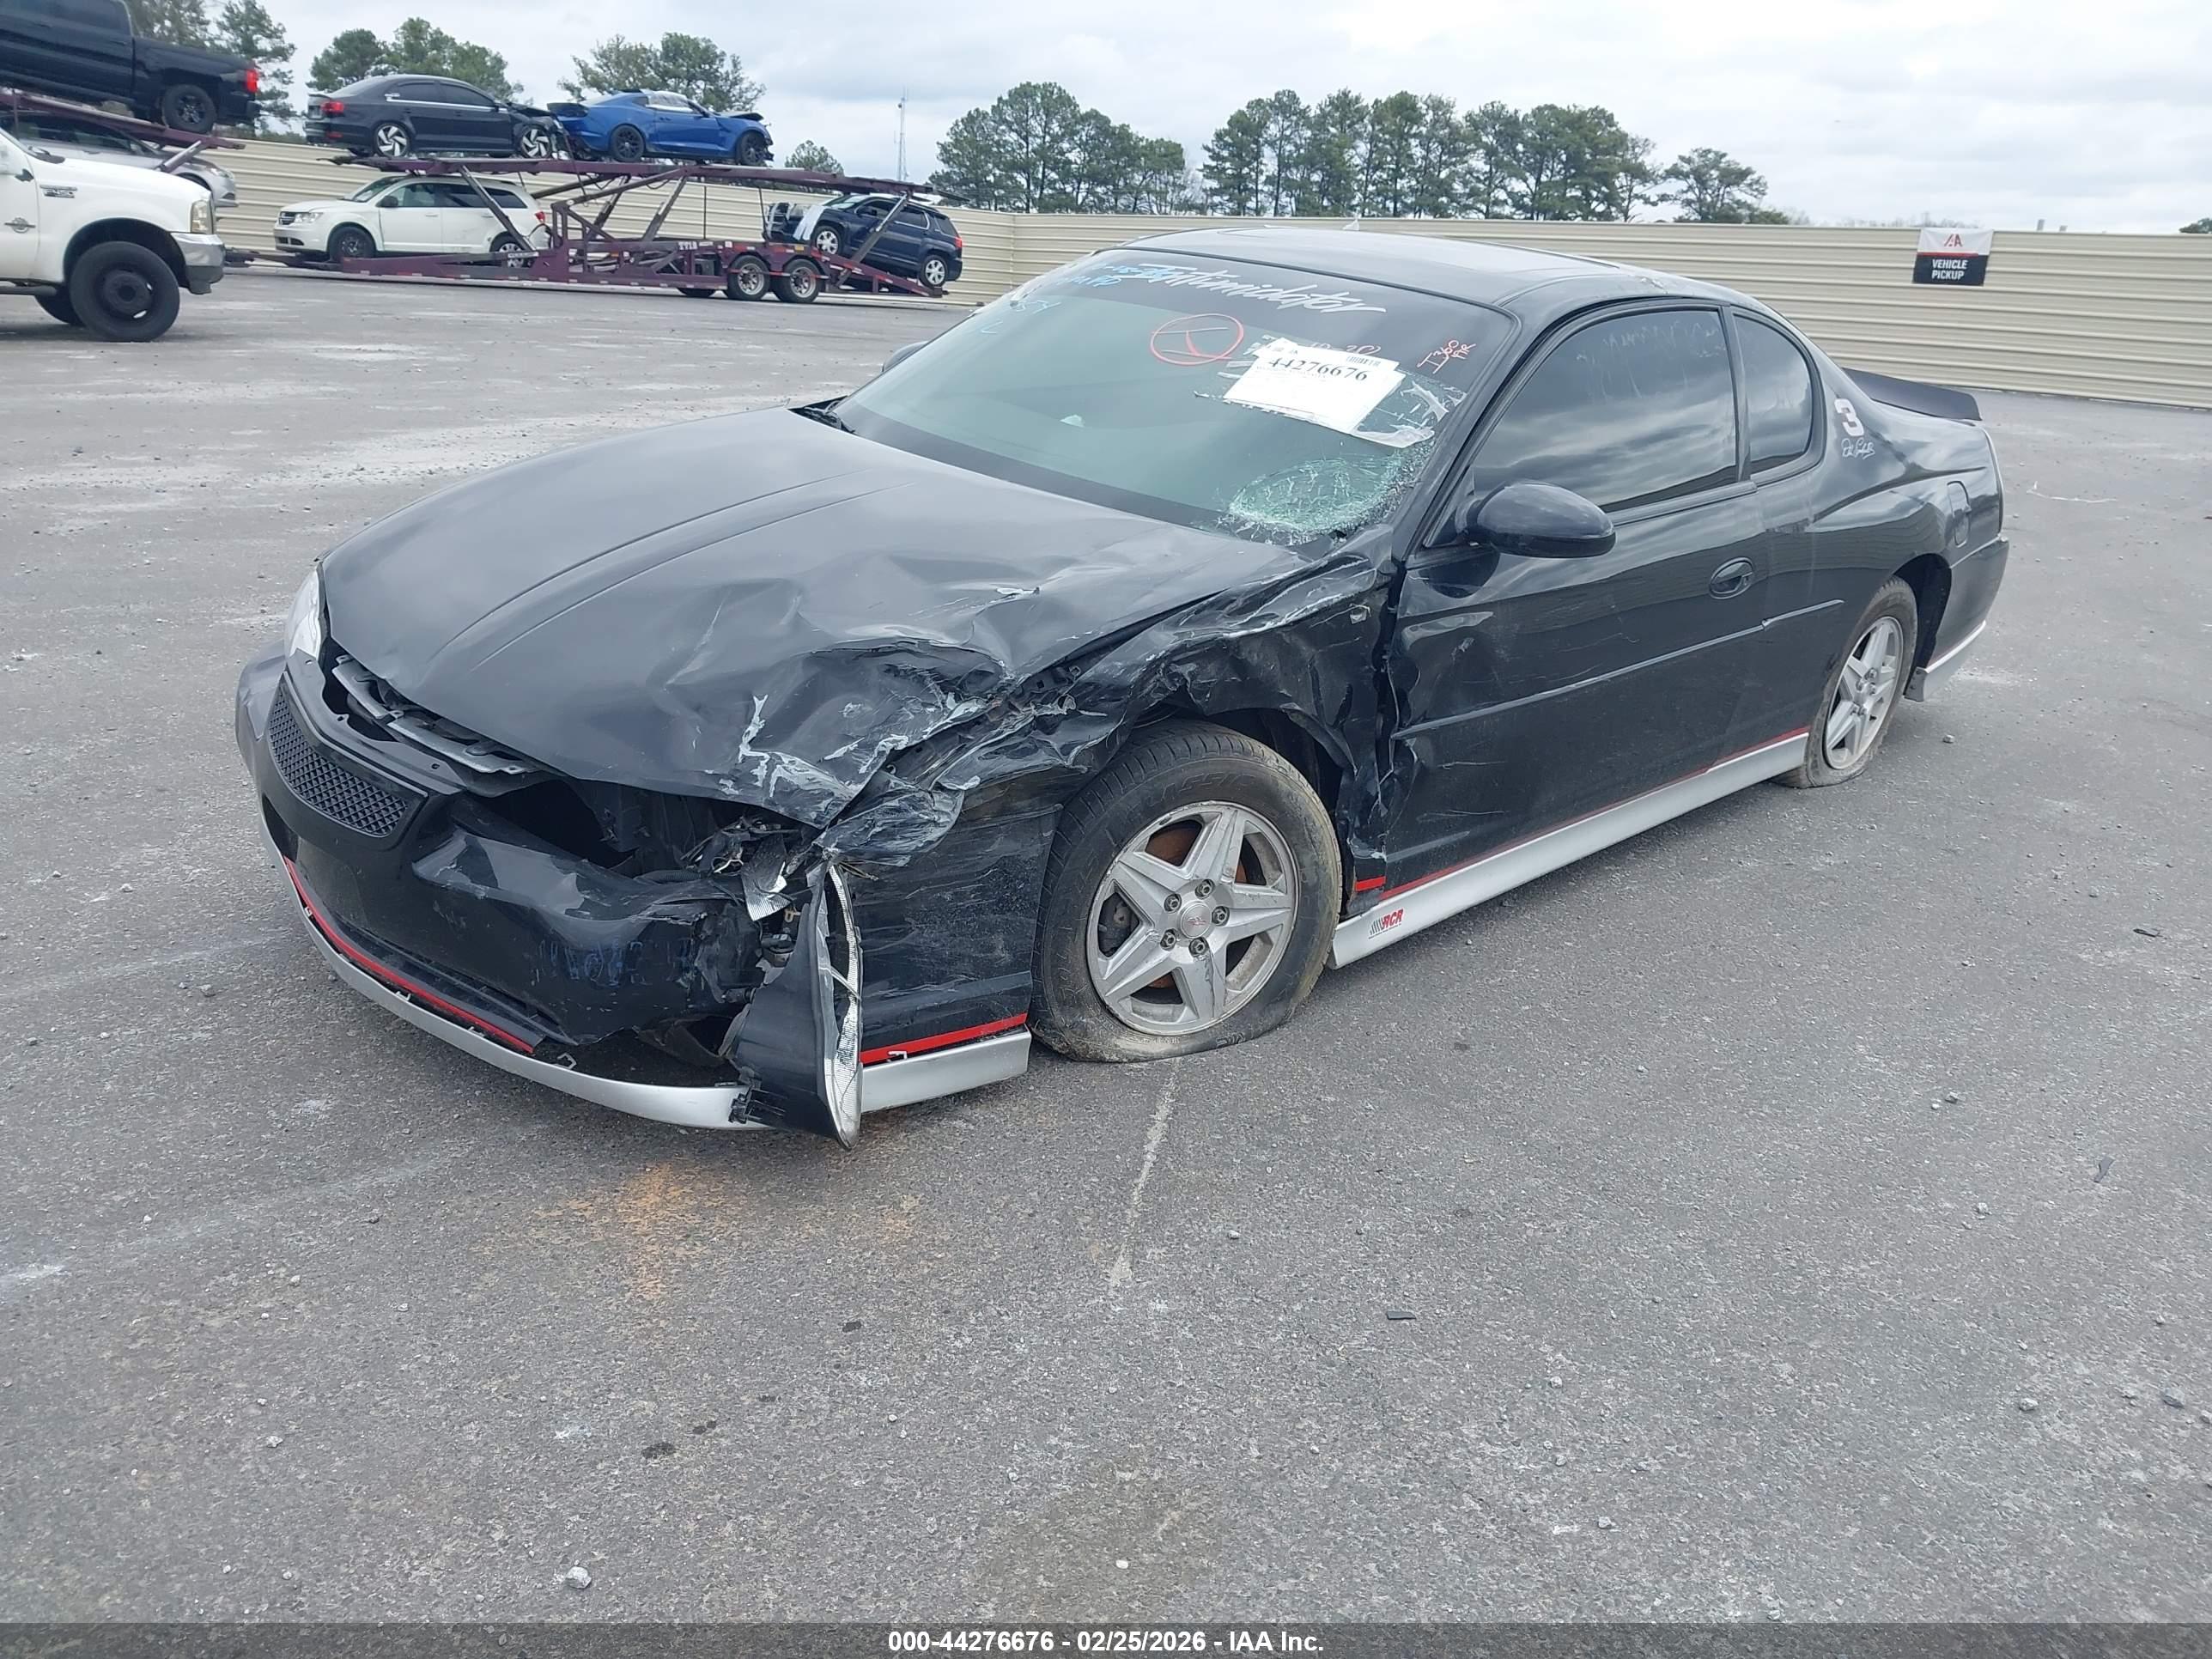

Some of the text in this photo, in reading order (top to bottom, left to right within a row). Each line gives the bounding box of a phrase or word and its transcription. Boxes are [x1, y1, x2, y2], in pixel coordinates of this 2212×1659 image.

[1931, 258, 1969, 270] VEHICLE
[1930, 269, 1966, 281] PICKUP
[1267, 356, 1372, 382] 44276676
[1833, 398, 1865, 437] 3
